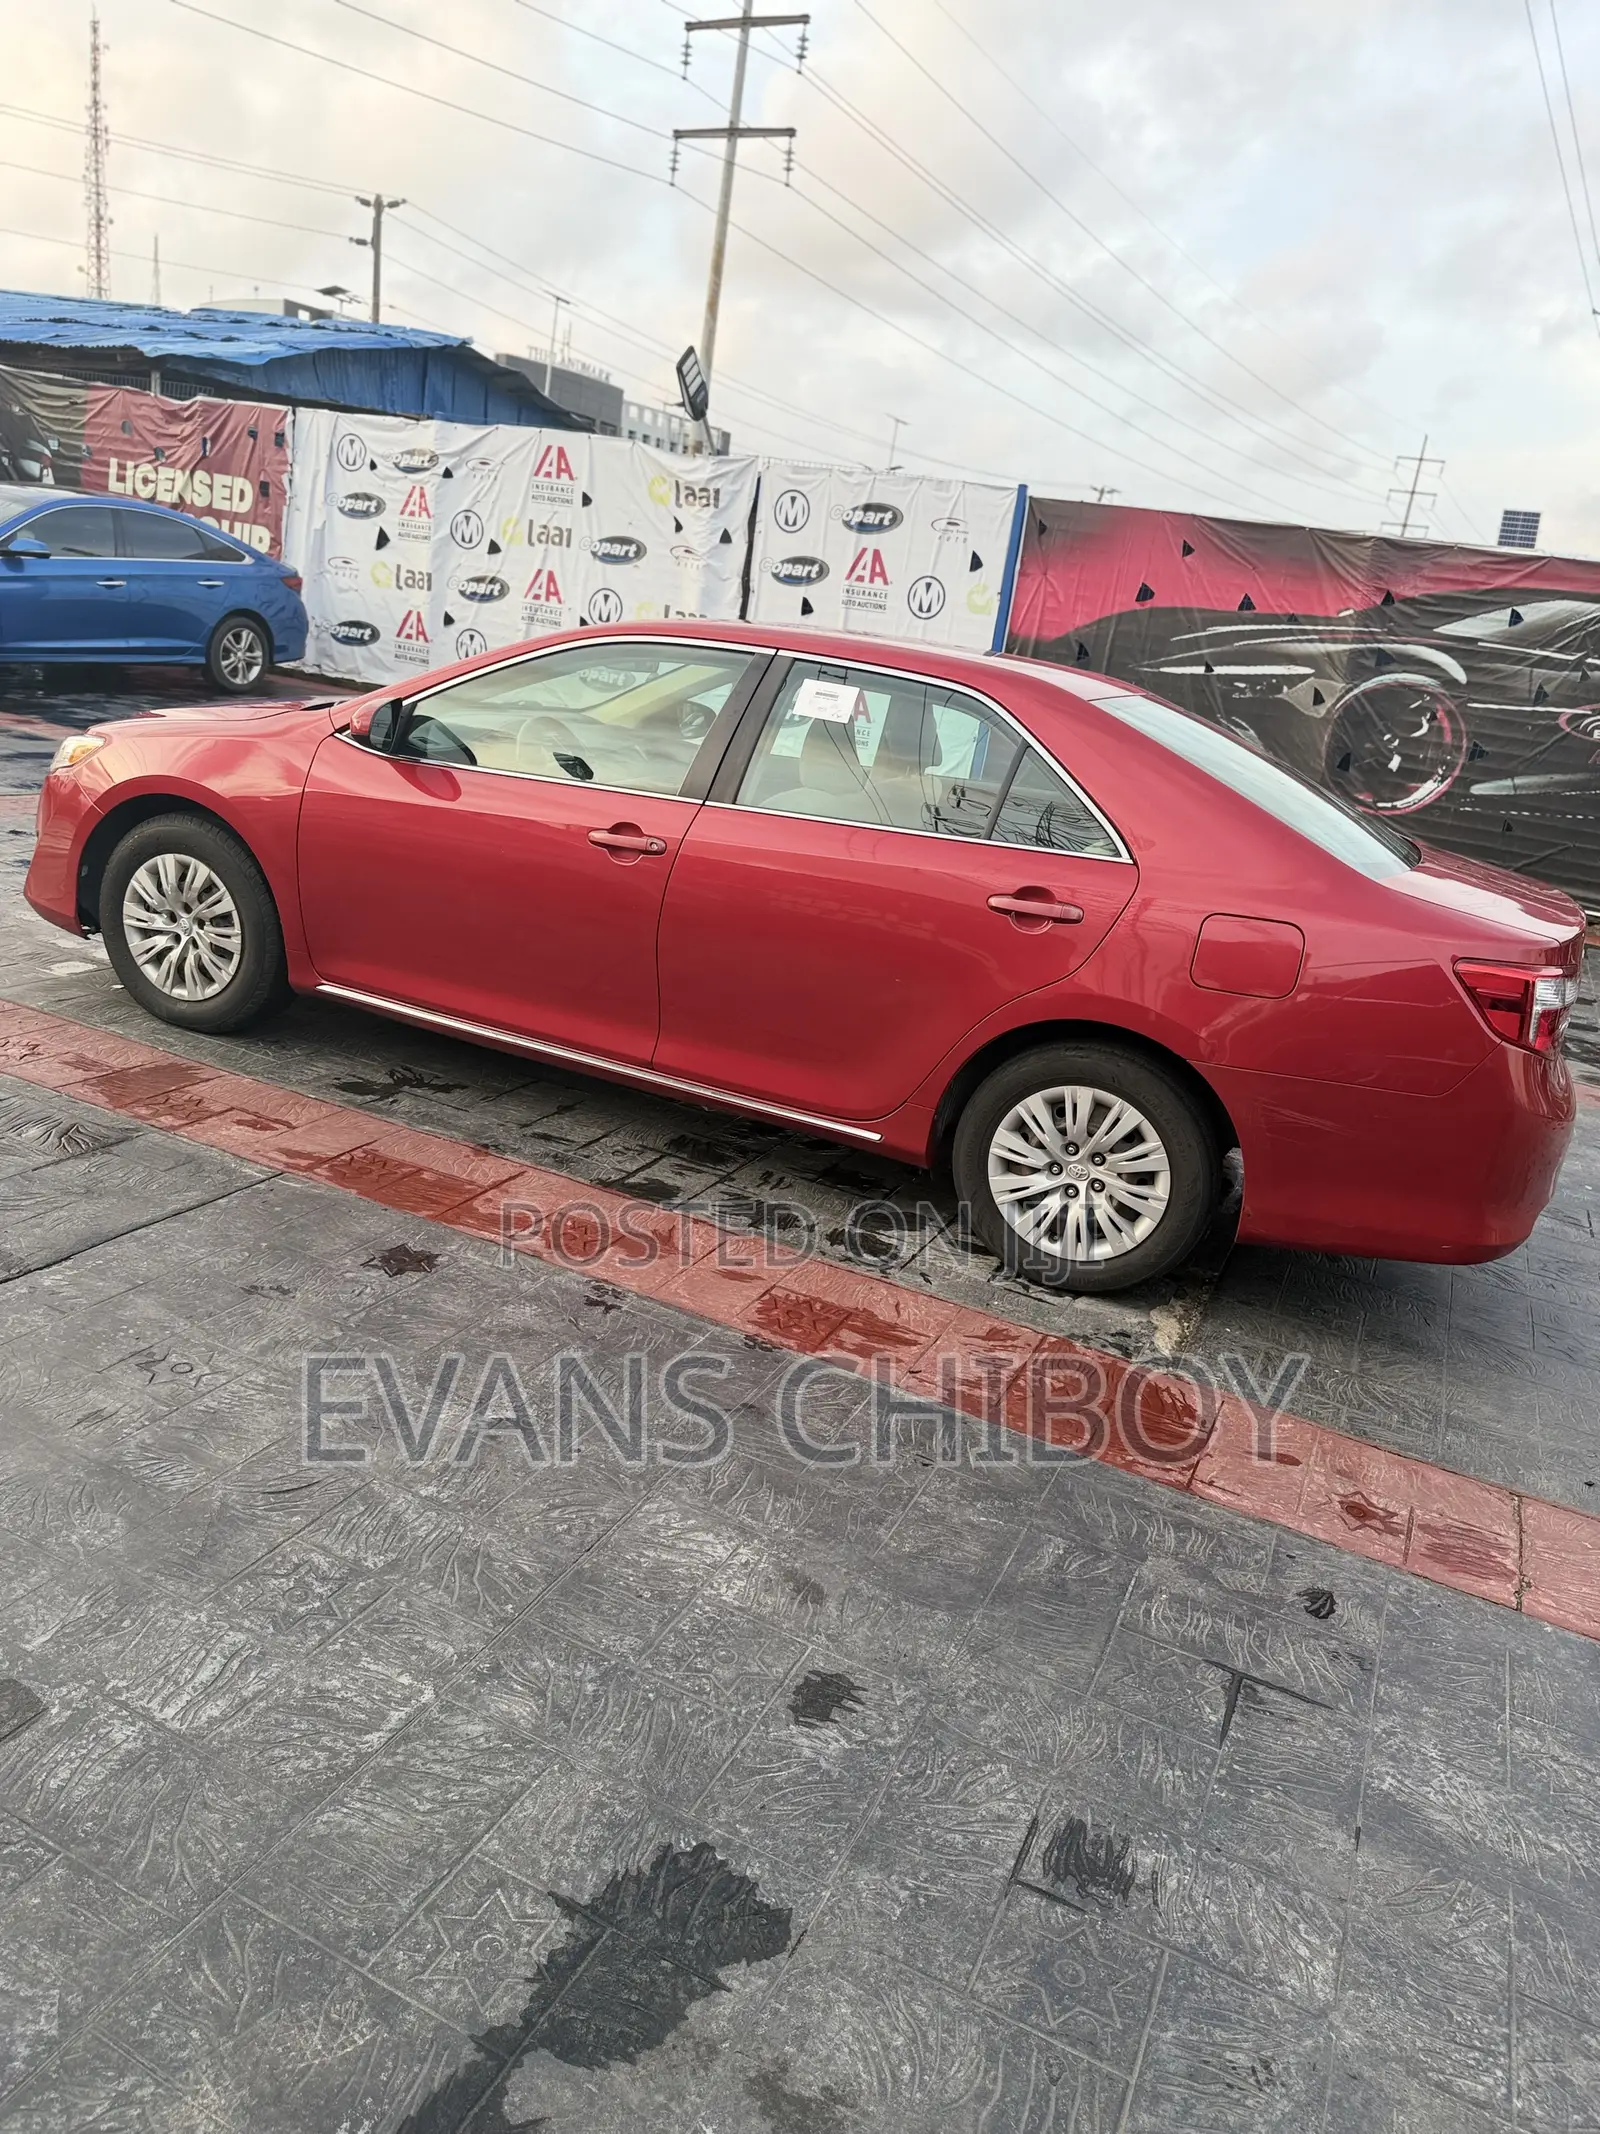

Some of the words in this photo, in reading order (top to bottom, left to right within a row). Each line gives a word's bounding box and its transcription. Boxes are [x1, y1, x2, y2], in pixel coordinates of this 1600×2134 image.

[108, 457, 253, 514] LICENSED
[532, 483, 574, 495] INSURANCE
[326, 492, 377, 513] Copart
[531, 494, 546, 502] AUTO
[547, 495, 574, 505] AUCTIONS
[830, 504, 894, 527] Copart
[579, 533, 637, 558] Copart
[759, 557, 820, 579] Copart
[447, 576, 501, 597] Copart
[842, 588, 888, 600] INSURANCE
[521, 605, 562, 617] INSURANCE
[841, 599, 856, 607] AUTO
[857, 601, 887, 611] AUCTIONS
[321, 619, 373, 640] Copart
[579, 666, 626, 687] opart
